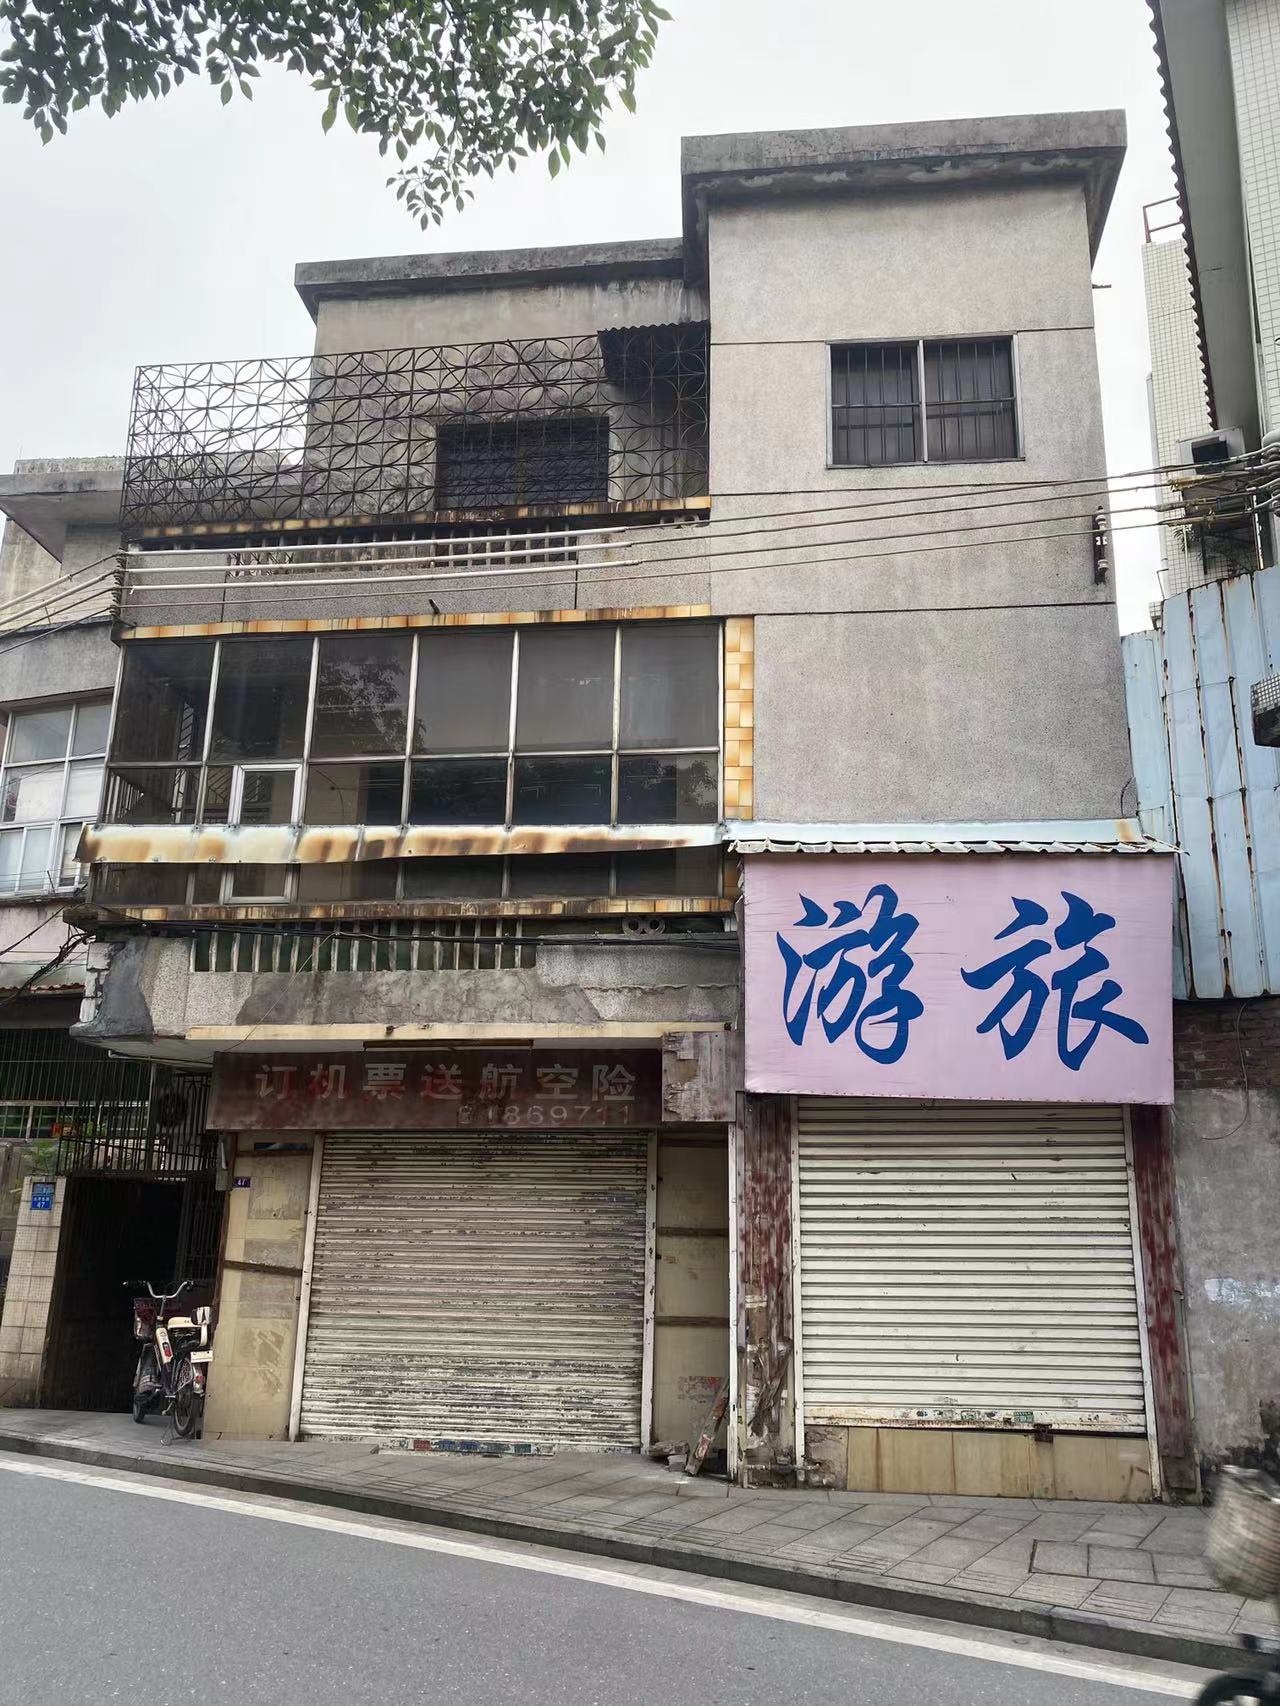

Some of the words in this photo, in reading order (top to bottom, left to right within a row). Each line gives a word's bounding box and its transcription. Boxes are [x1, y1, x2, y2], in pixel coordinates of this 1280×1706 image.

[255, 1063, 636, 1100] 订机票送航空险
